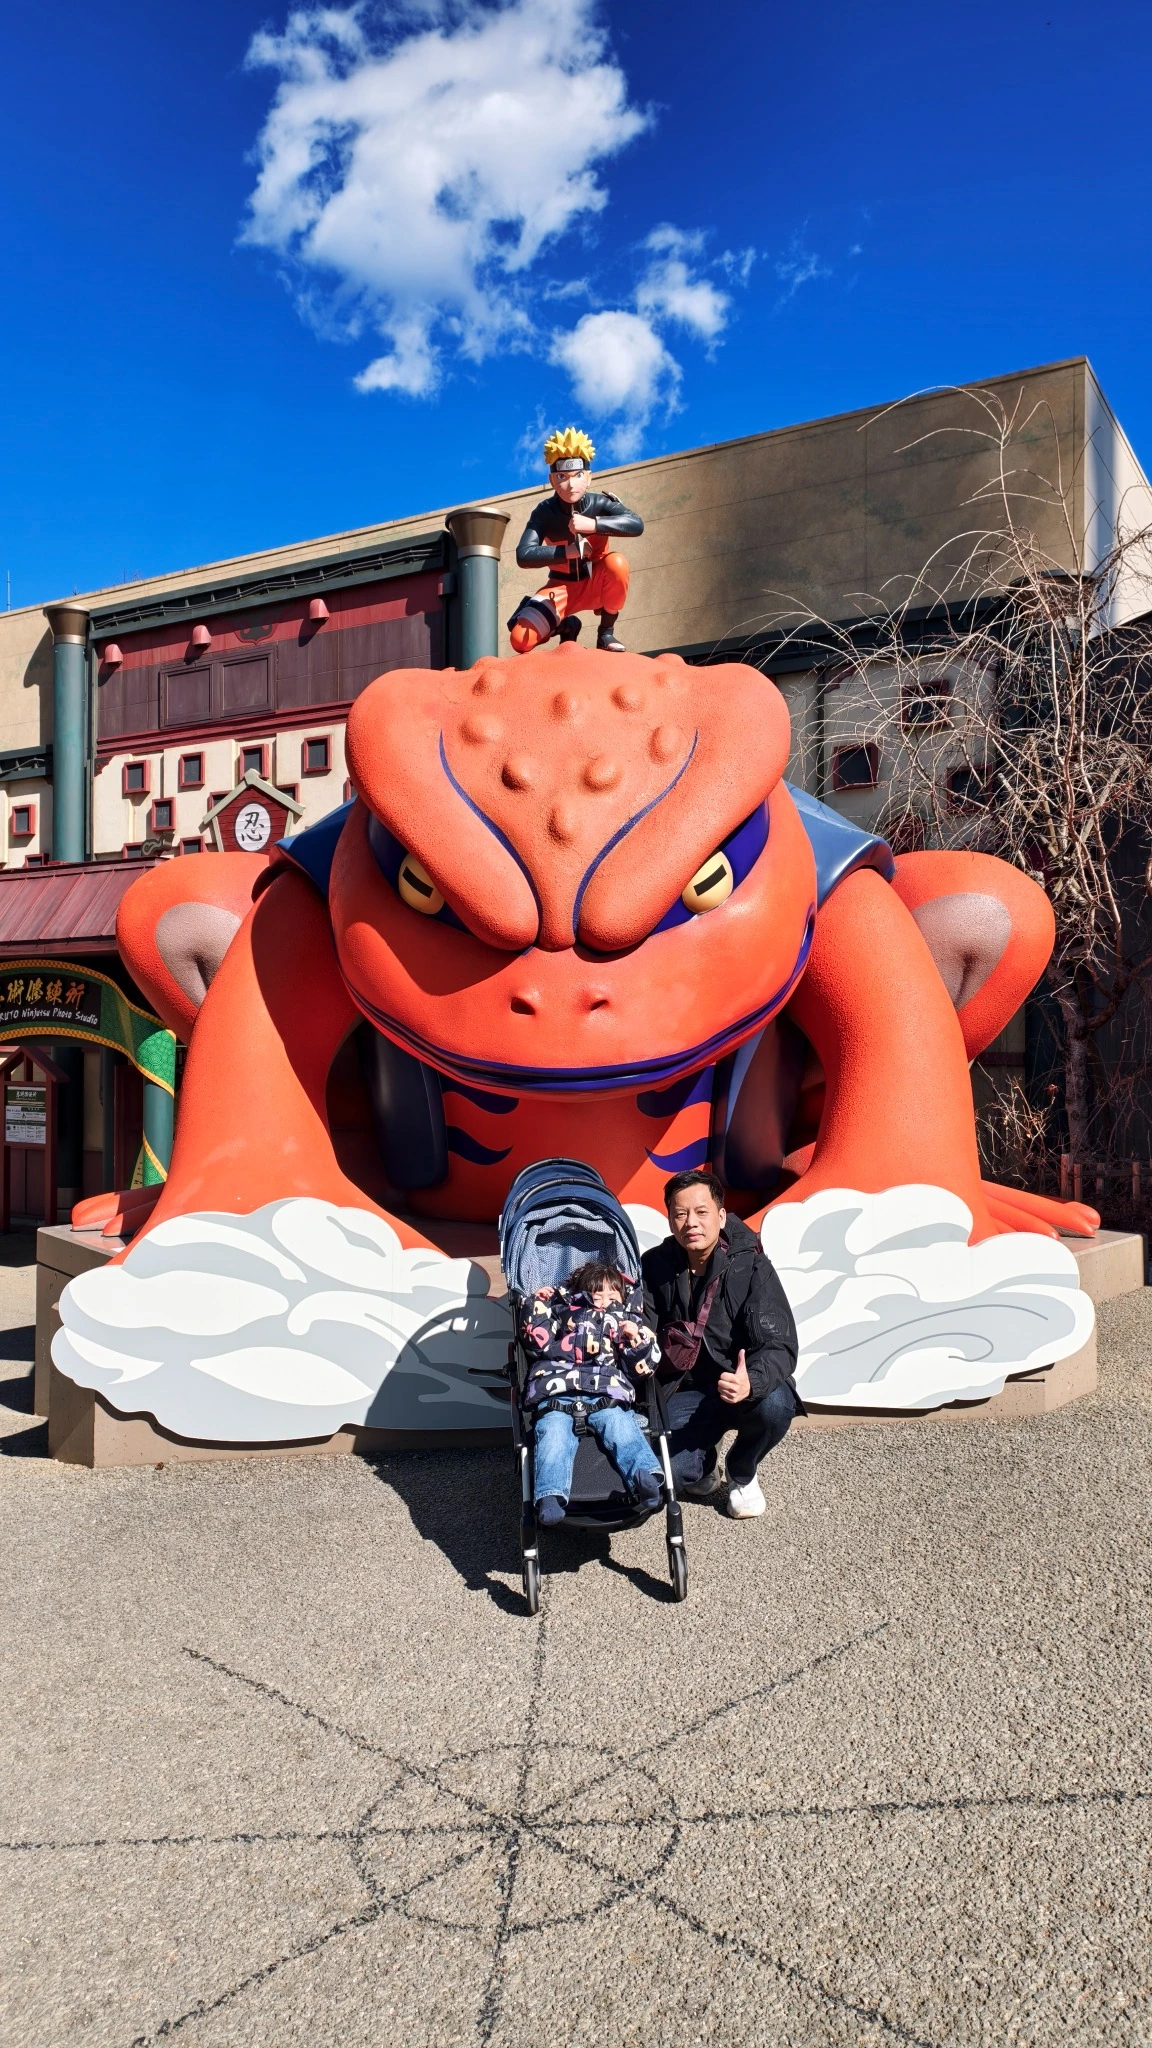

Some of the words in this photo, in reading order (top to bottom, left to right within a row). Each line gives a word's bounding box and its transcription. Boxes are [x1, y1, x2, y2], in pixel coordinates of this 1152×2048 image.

[241, 811, 265, 842] 忍
[0, 977, 85, 1010] 術修練所
[21, 1007, 50, 1019] Ninjutsu
[52, 1007, 72, 1018] Photo
[75, 1011, 98, 1025] Studio
